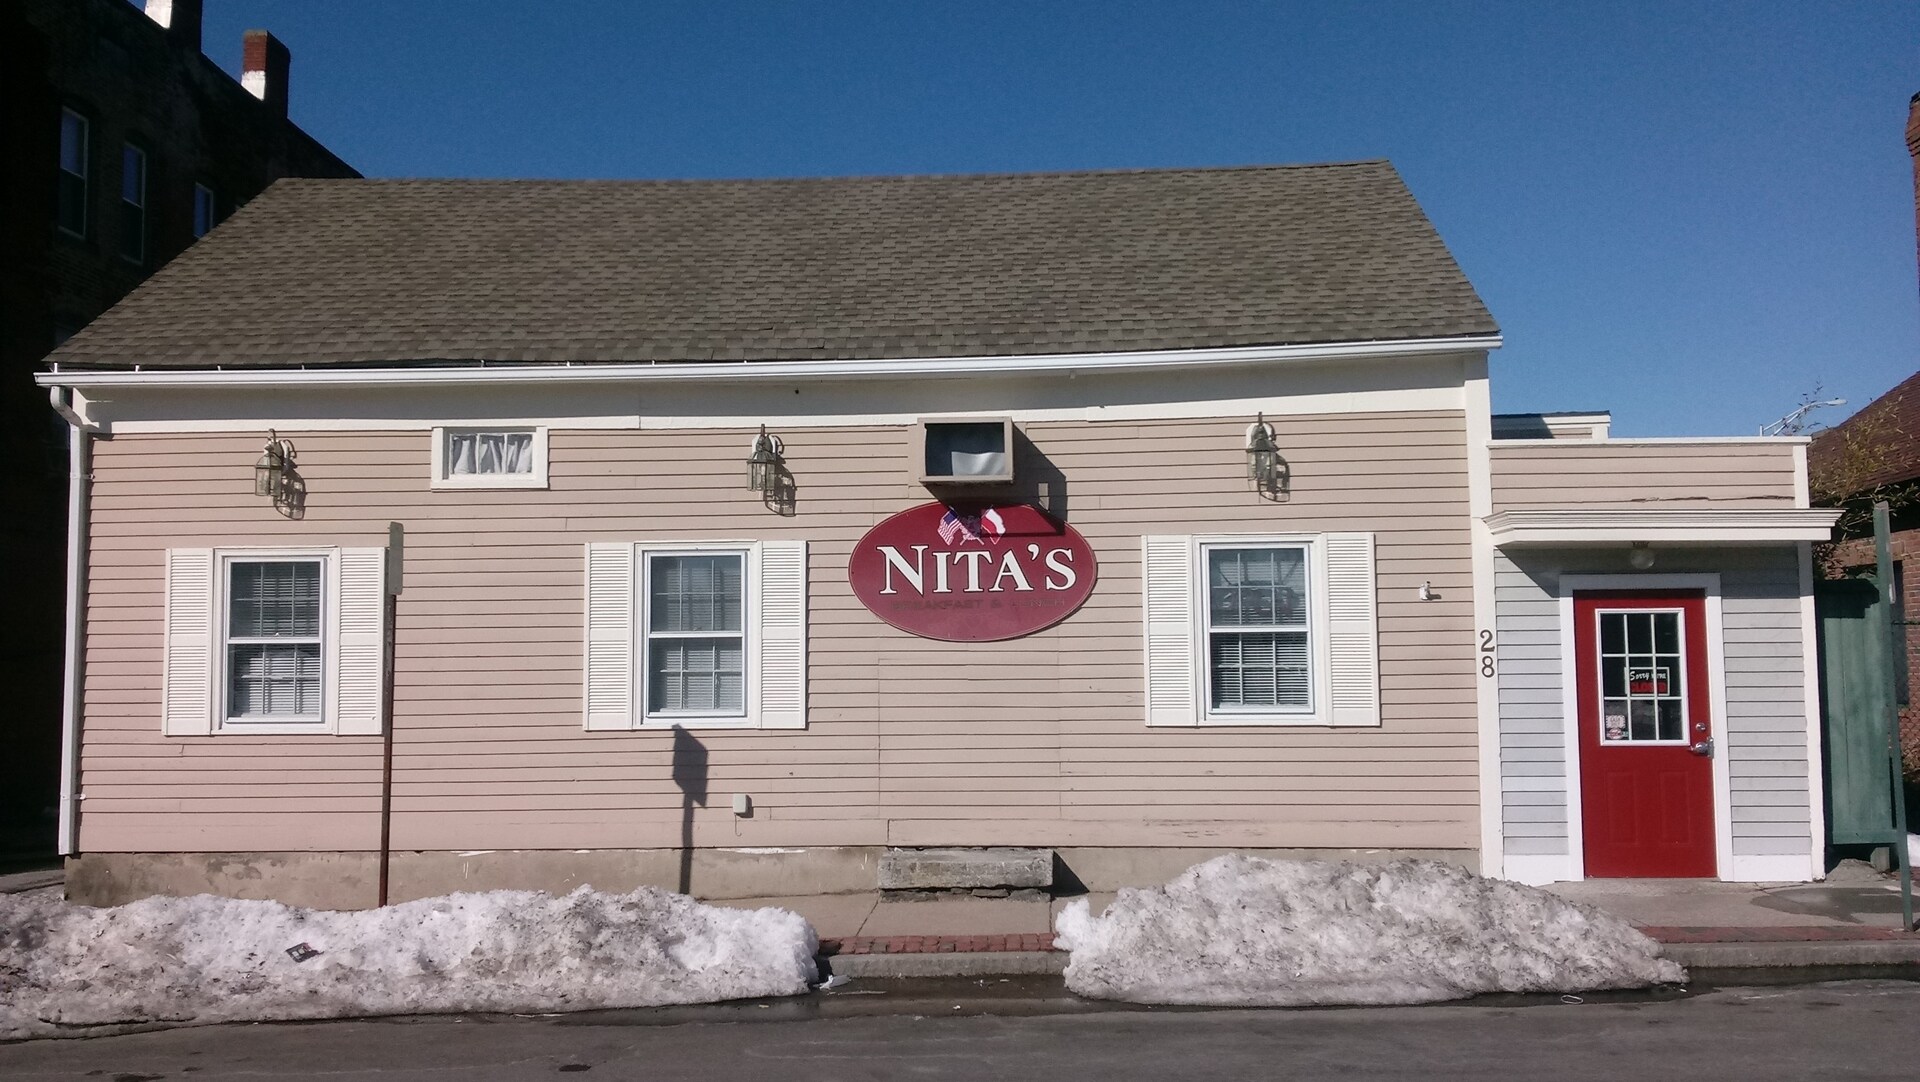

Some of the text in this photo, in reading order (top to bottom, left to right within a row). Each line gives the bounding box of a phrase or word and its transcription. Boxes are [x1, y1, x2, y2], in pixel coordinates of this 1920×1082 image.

[876, 543, 1077, 595] NITA'S
[1480, 629, 1495, 678] 28
[1631, 681, 1666, 693] CLOSD
